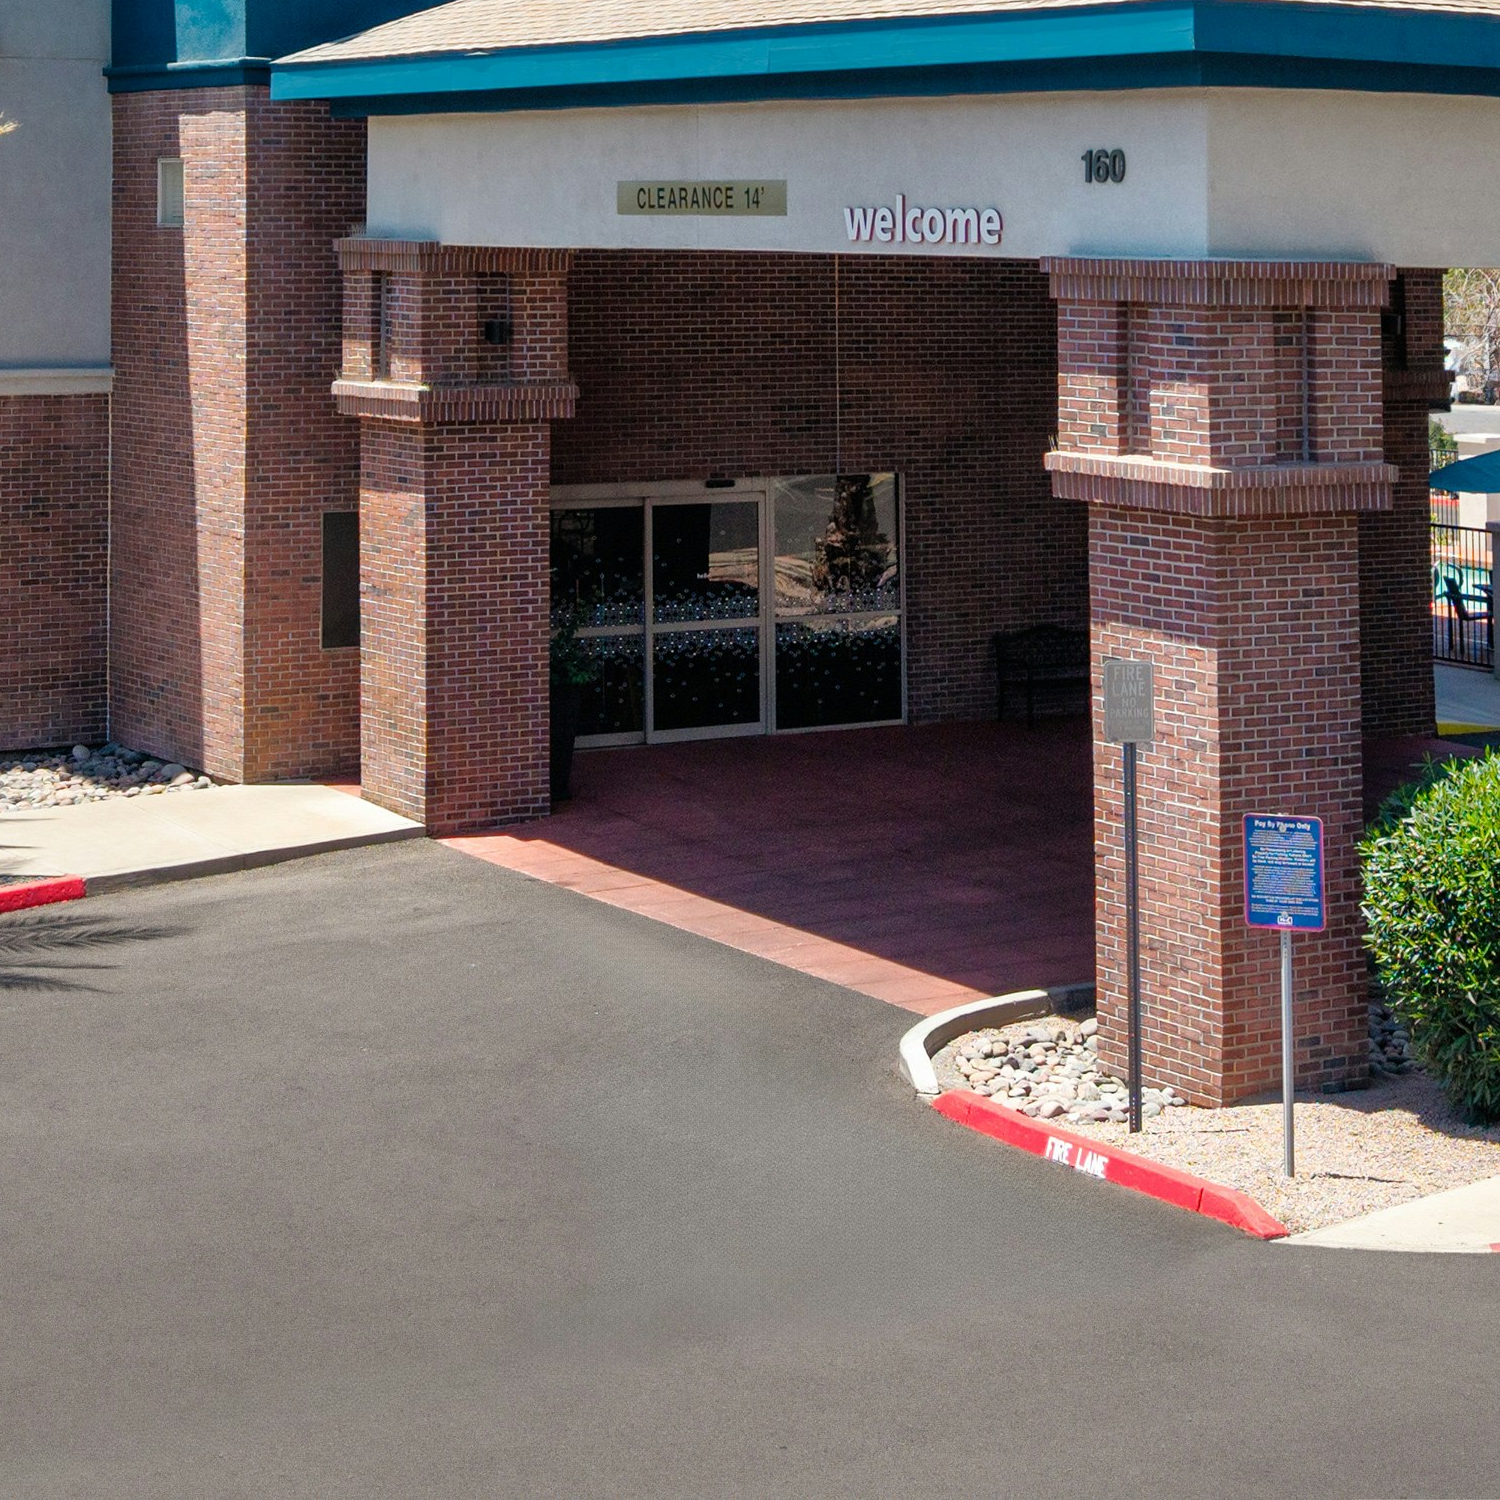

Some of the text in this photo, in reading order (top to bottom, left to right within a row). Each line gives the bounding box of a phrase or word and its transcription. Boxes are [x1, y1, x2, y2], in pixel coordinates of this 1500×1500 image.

[1081, 149, 1126, 184] 160
[637, 186, 735, 210] CLEARANCE
[844, 193, 1002, 244] welcome
[1113, 665, 1144, 681] FIRE
[1112, 681, 1146, 697] LANE
[1122, 697, 1137, 708] NO
[1110, 708, 1149, 719] PARKING
[1045, 1136, 1109, 1179] FIRE LANE
